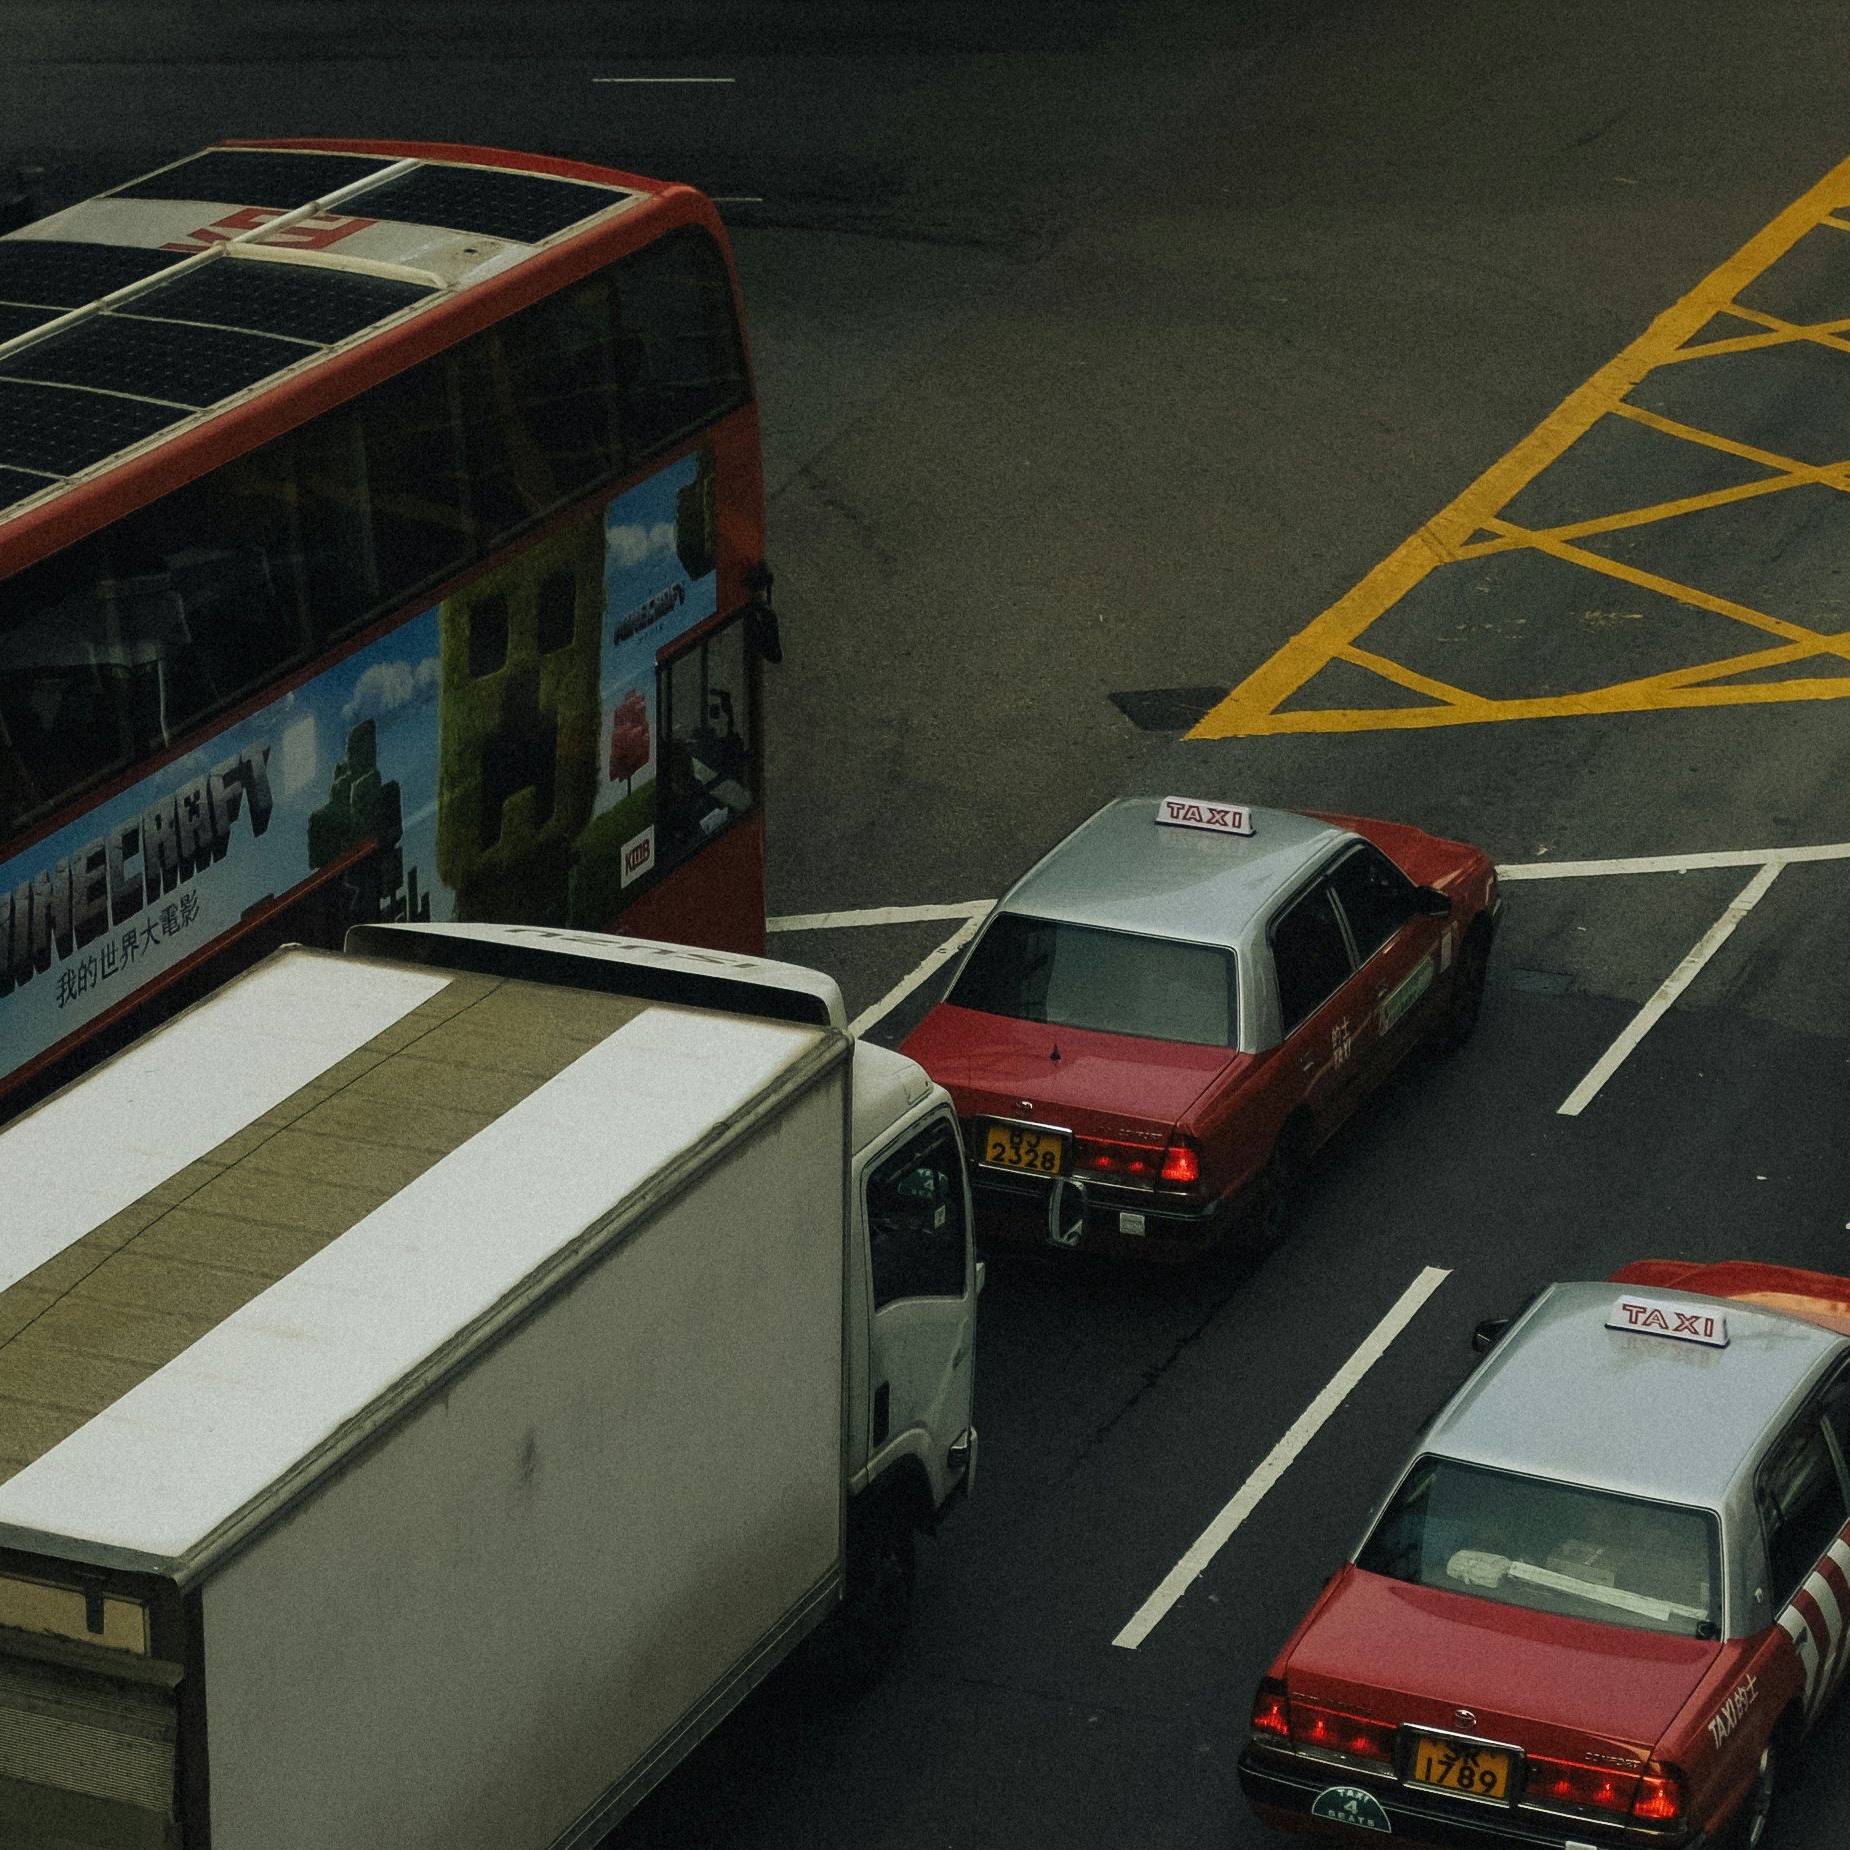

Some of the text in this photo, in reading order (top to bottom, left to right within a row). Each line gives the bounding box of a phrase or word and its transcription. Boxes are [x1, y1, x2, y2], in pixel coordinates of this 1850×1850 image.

[1166, 801, 1243, 830] TAXI
[624, 837, 651, 876] KMB
[55, 888, 199, 1009] 我的世界大電影
[1009, 1125, 1041, 1149] BJ
[992, 1141, 1056, 1171] 2328
[1622, 1303, 1716, 1337] TAXI
[1423, 1756, 1499, 1795] 1789
[1337, 1788, 1371, 1804] TAXI
[1342, 1799, 1359, 1815] 4
[1327, 1809, 1376, 1828] SEATS
